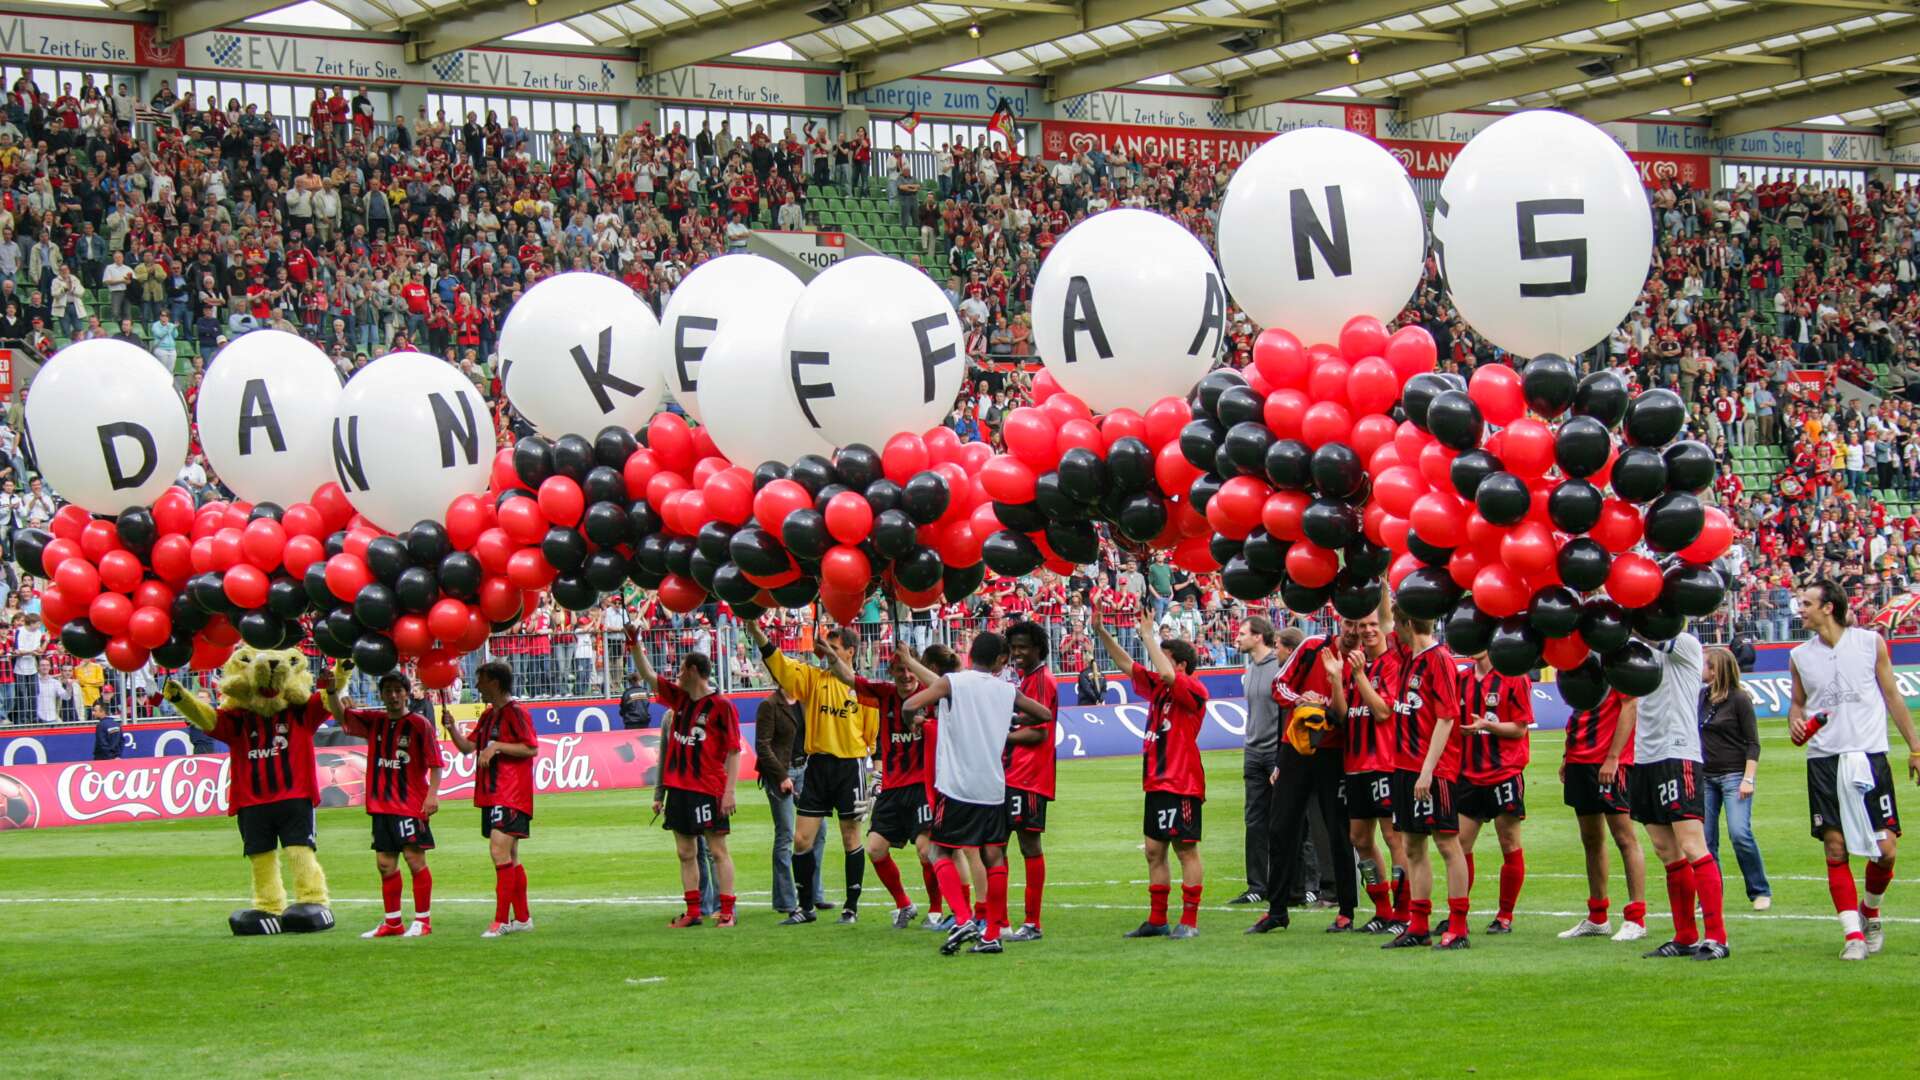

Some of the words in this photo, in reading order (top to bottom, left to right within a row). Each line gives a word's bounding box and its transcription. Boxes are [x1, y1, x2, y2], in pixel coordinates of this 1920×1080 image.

[39, 36, 72, 57] Zeit
[74, 39, 97, 58] für
[101, 41, 129, 60] Sie.
[248, 36, 306, 73] EVL
[315, 56, 344, 75] Zeit
[349, 59, 370, 77] für
[375, 60, 401, 79] Sie.
[468, 52, 518, 86] EVL
[523, 70, 549, 89] Zeit
[656, 67, 704, 98] EVL
[708, 82, 734, 100] Zeit
[760, 86, 784, 103] Sie.
[943, 91, 980, 110] zum
[1090, 94, 1131, 123] EVL
[1134, 108, 1155, 124] Zeit
[1159, 110, 1175, 126] für
[1178, 111, 1197, 127] Sie.
[1275, 116, 1296, 133] Zeit
[1410, 115, 1447, 140] EVL
[1450, 126, 1469, 141] Zeit
[1656, 125, 1680, 149] Mit
[1741, 138, 1768, 153] zum
[1772, 132, 1806, 158] Sieg!
[1851, 136, 1880, 161] EVL
[1290, 184, 1353, 281] N
[799, 252, 838, 268] SHOP
[1517, 198, 1589, 298] S
[1062, 275, 1115, 364] A
[569, 325, 645, 415] K
[911, 312, 957, 404] F
[238, 378, 288, 456] A
[427, 390, 479, 469] N
[96, 421, 158, 491] D
[820, 705, 848, 719] RWE
[1348, 705, 1371, 718] RWE
[248, 746, 279, 760] RWE
[57, 757, 232, 820] Coca-Col
[1371, 777, 1391, 802] 26
[1494, 781, 1514, 806] 13
[1657, 779, 1679, 806] 28
[694, 803, 712, 824] 16
[916, 803, 934, 824] 10
[1010, 796, 1022, 816] 3
[1157, 808, 1178, 829] 27
[1879, 794, 1893, 818] 9
[399, 818, 416, 837] 15
